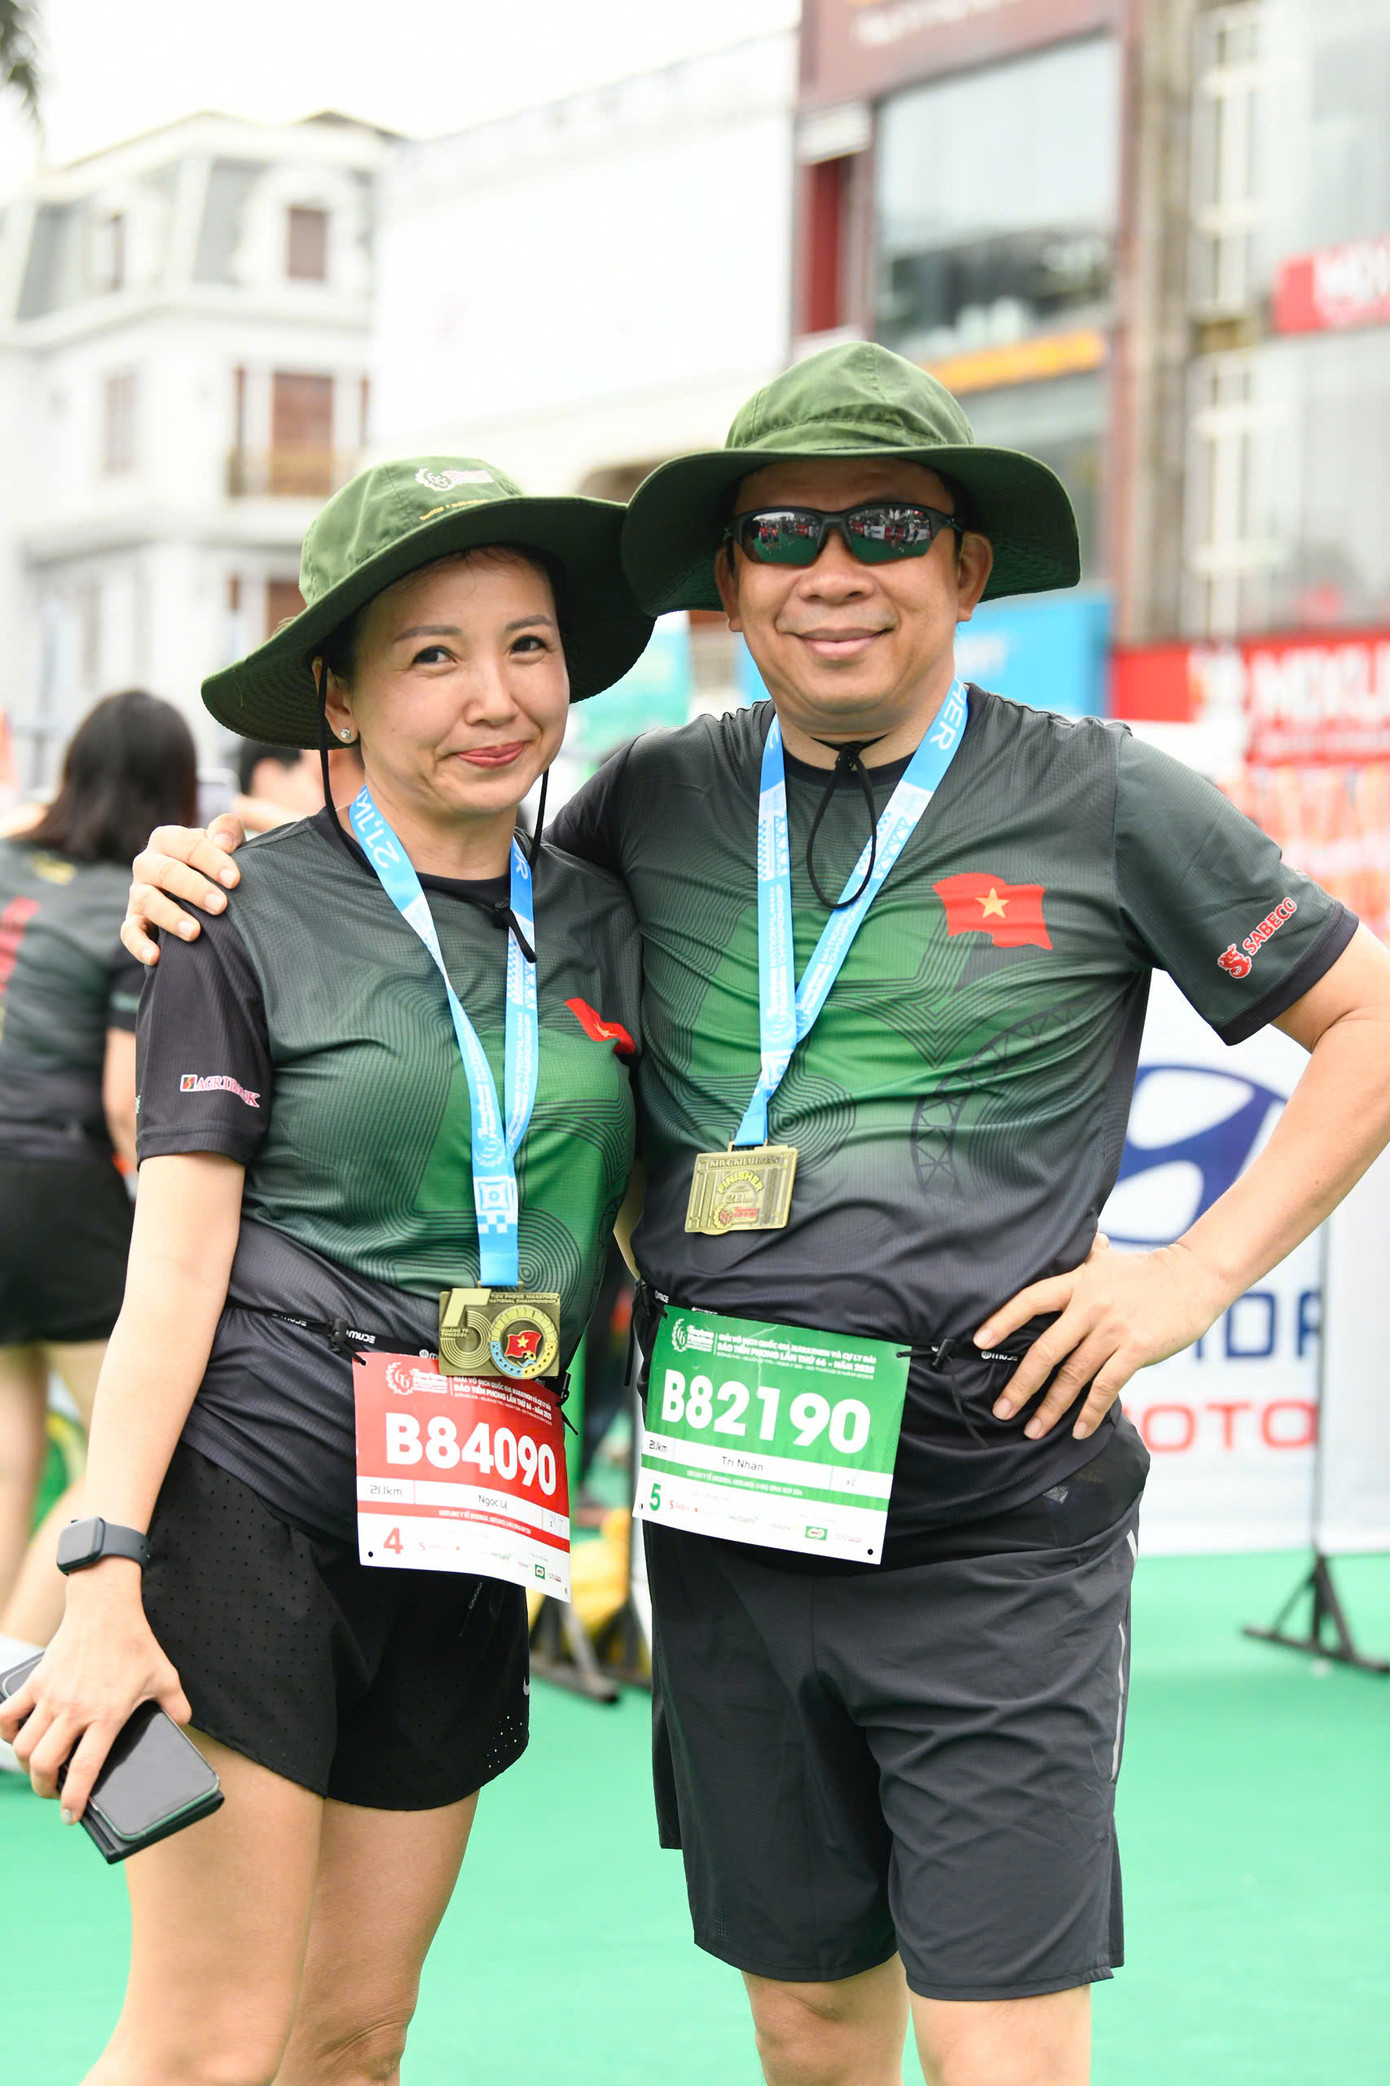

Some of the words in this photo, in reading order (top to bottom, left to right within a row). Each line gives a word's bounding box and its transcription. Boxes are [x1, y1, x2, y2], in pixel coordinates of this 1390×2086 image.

[1242, 896, 1298, 956] SABECO
[716, 1170, 764, 1195] FINISHER
[661, 1368, 871, 1454] B82190
[385, 1411, 557, 1496] B84090
[649, 1482, 662, 1512] 5
[382, 1526, 404, 1555] 4
